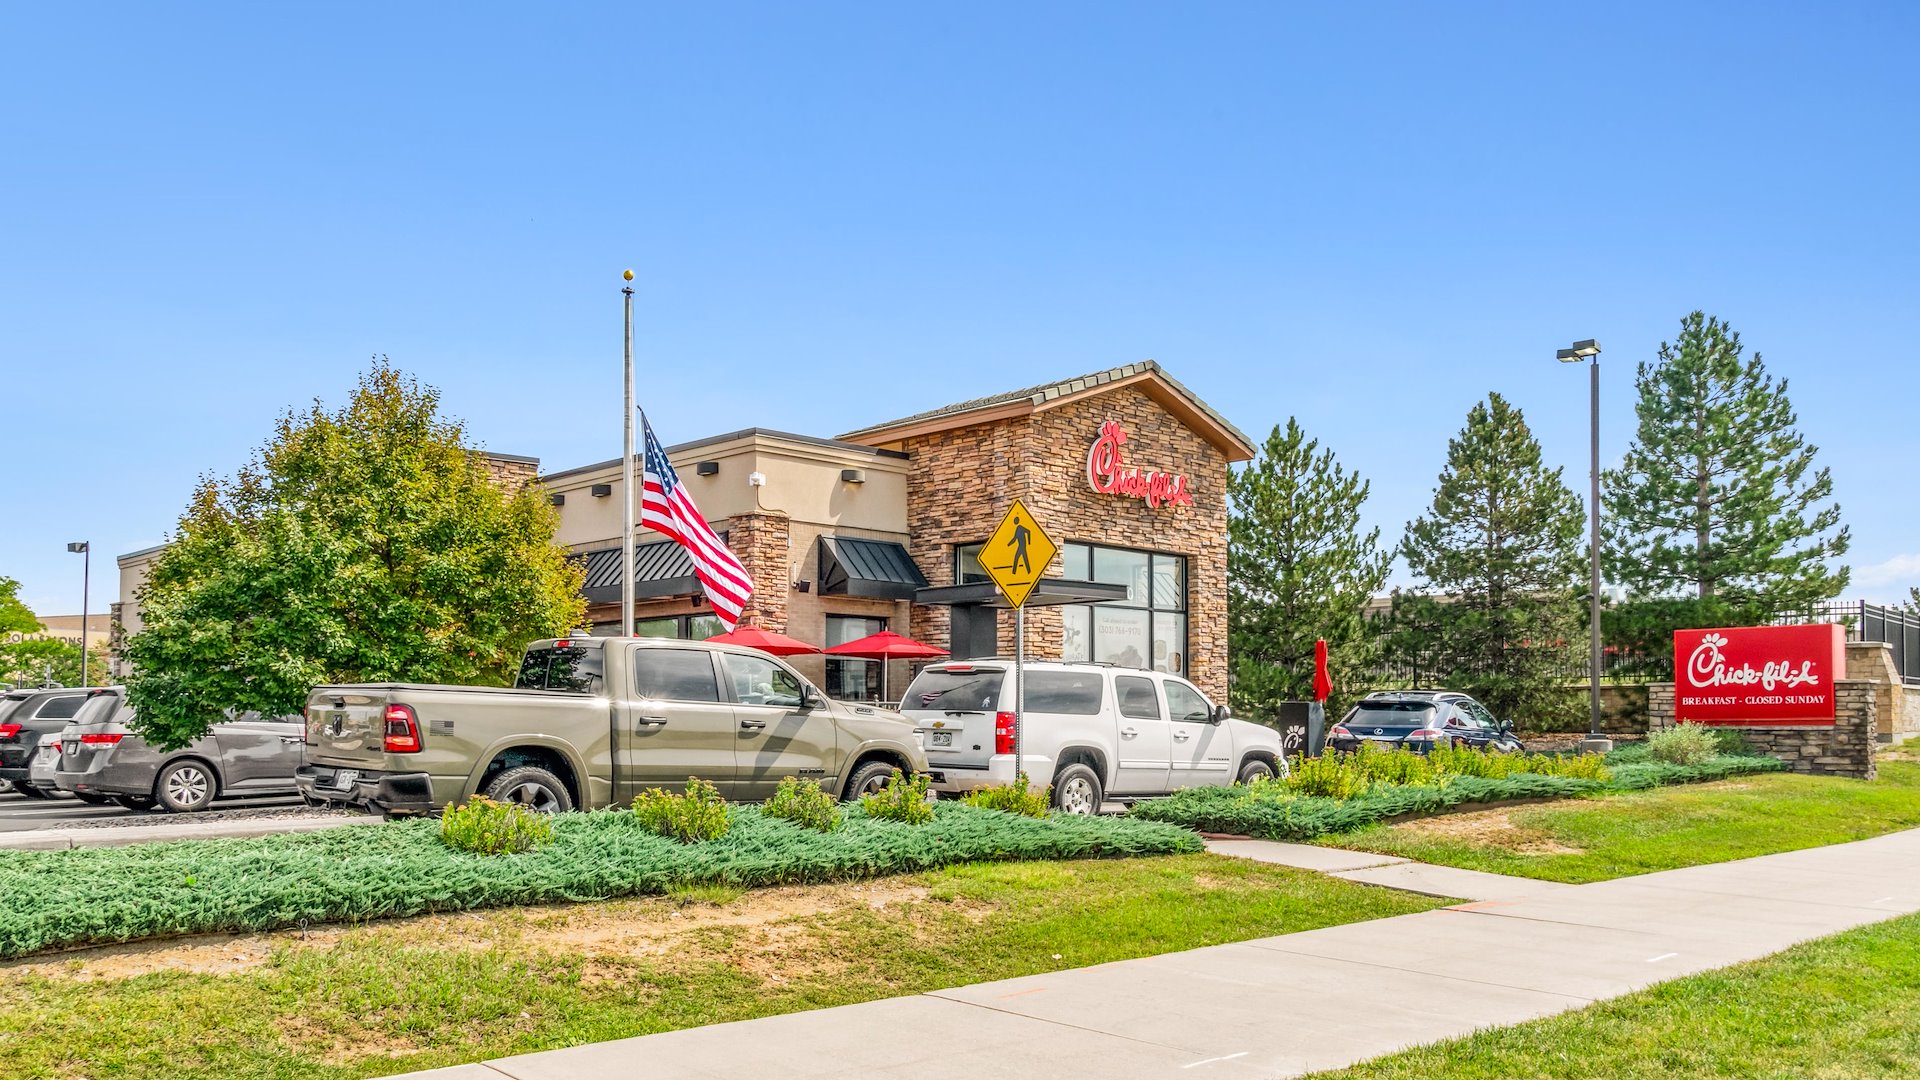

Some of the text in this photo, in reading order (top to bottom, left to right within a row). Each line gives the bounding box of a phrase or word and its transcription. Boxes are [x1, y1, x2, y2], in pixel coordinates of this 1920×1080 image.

[1087, 421, 1193, 510] Chick-fil-A
[1688, 633, 1819, 691] Chick-fil-A
[1682, 697, 1737, 706] BREAKFAST
[1745, 696, 1783, 705] CLOSED
[1785, 695, 1826, 704] SUNDAY
